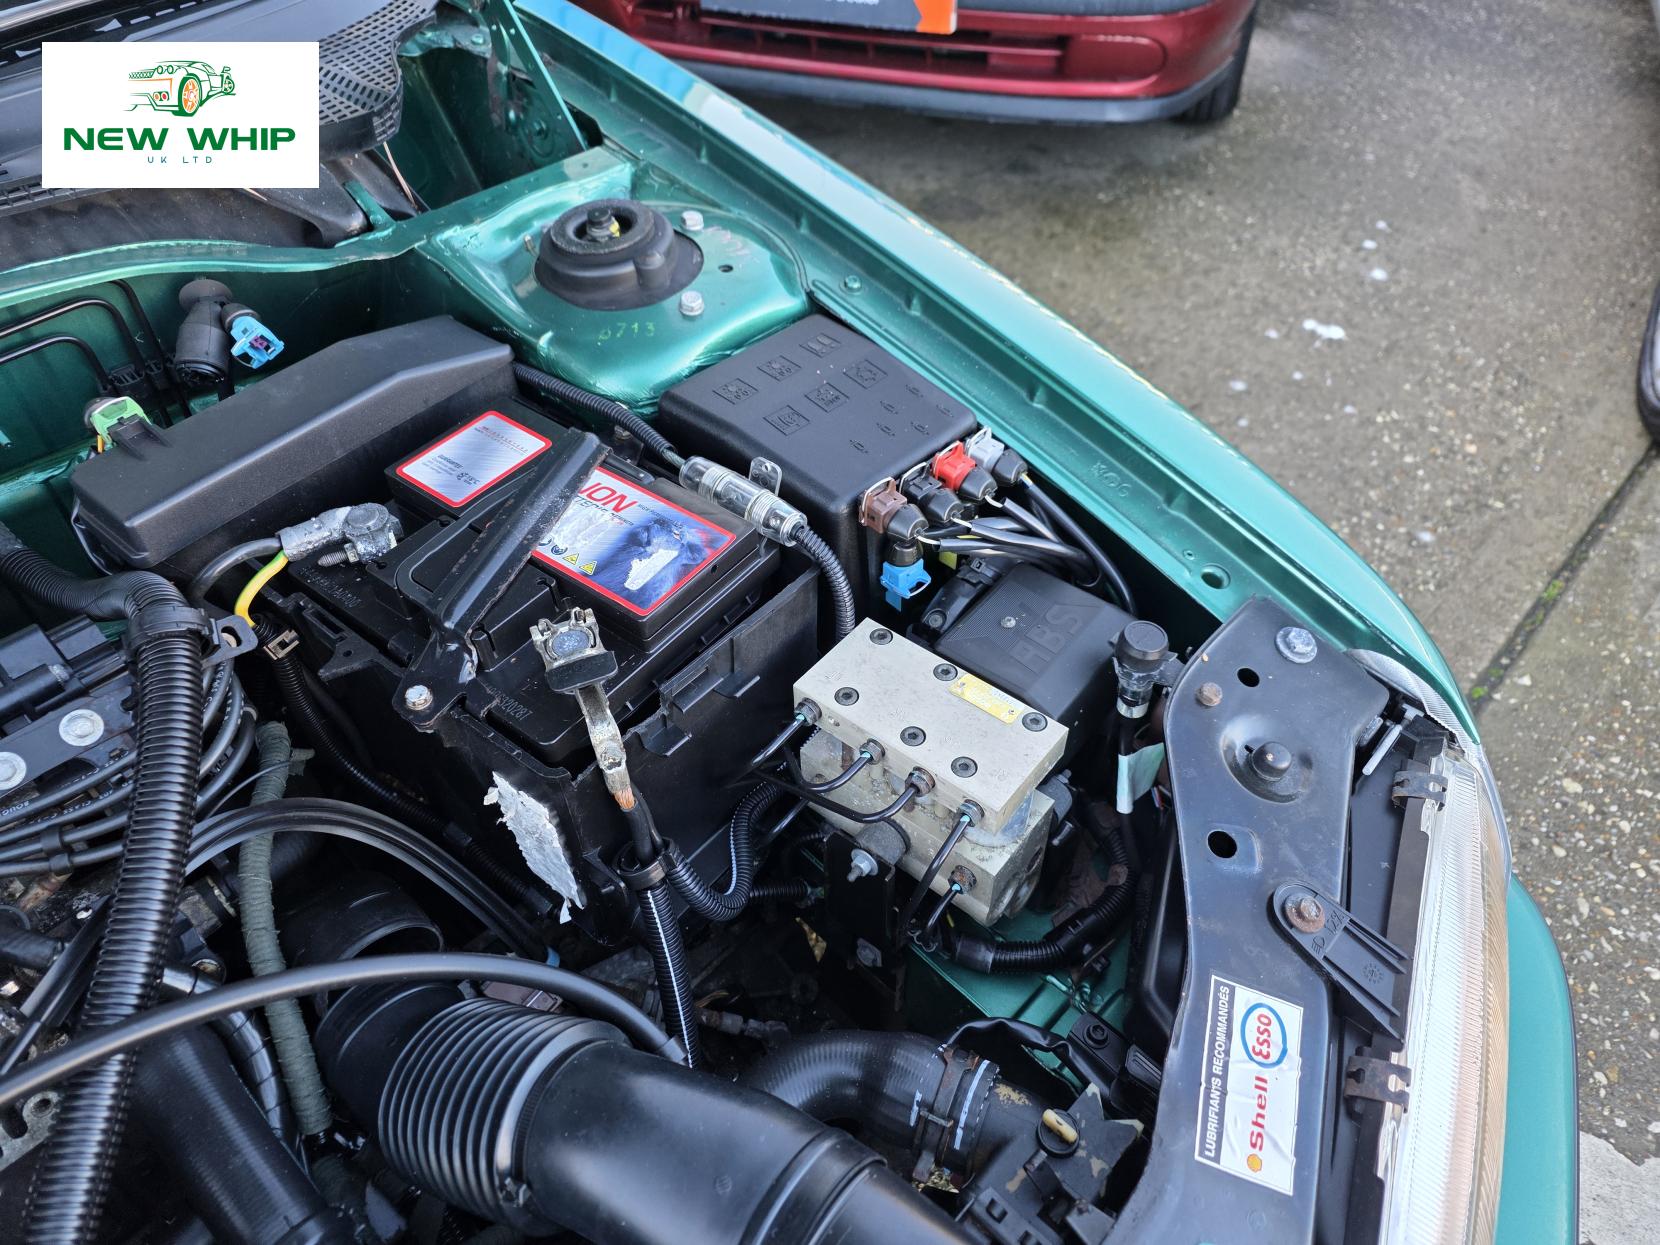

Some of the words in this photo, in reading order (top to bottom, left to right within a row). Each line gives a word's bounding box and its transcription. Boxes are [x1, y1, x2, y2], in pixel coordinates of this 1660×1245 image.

[578, 482, 639, 513] ION
[1205, 1077, 1222, 1158] LUBRIFIANTS
[1250, 1076, 1268, 1152] Shell
